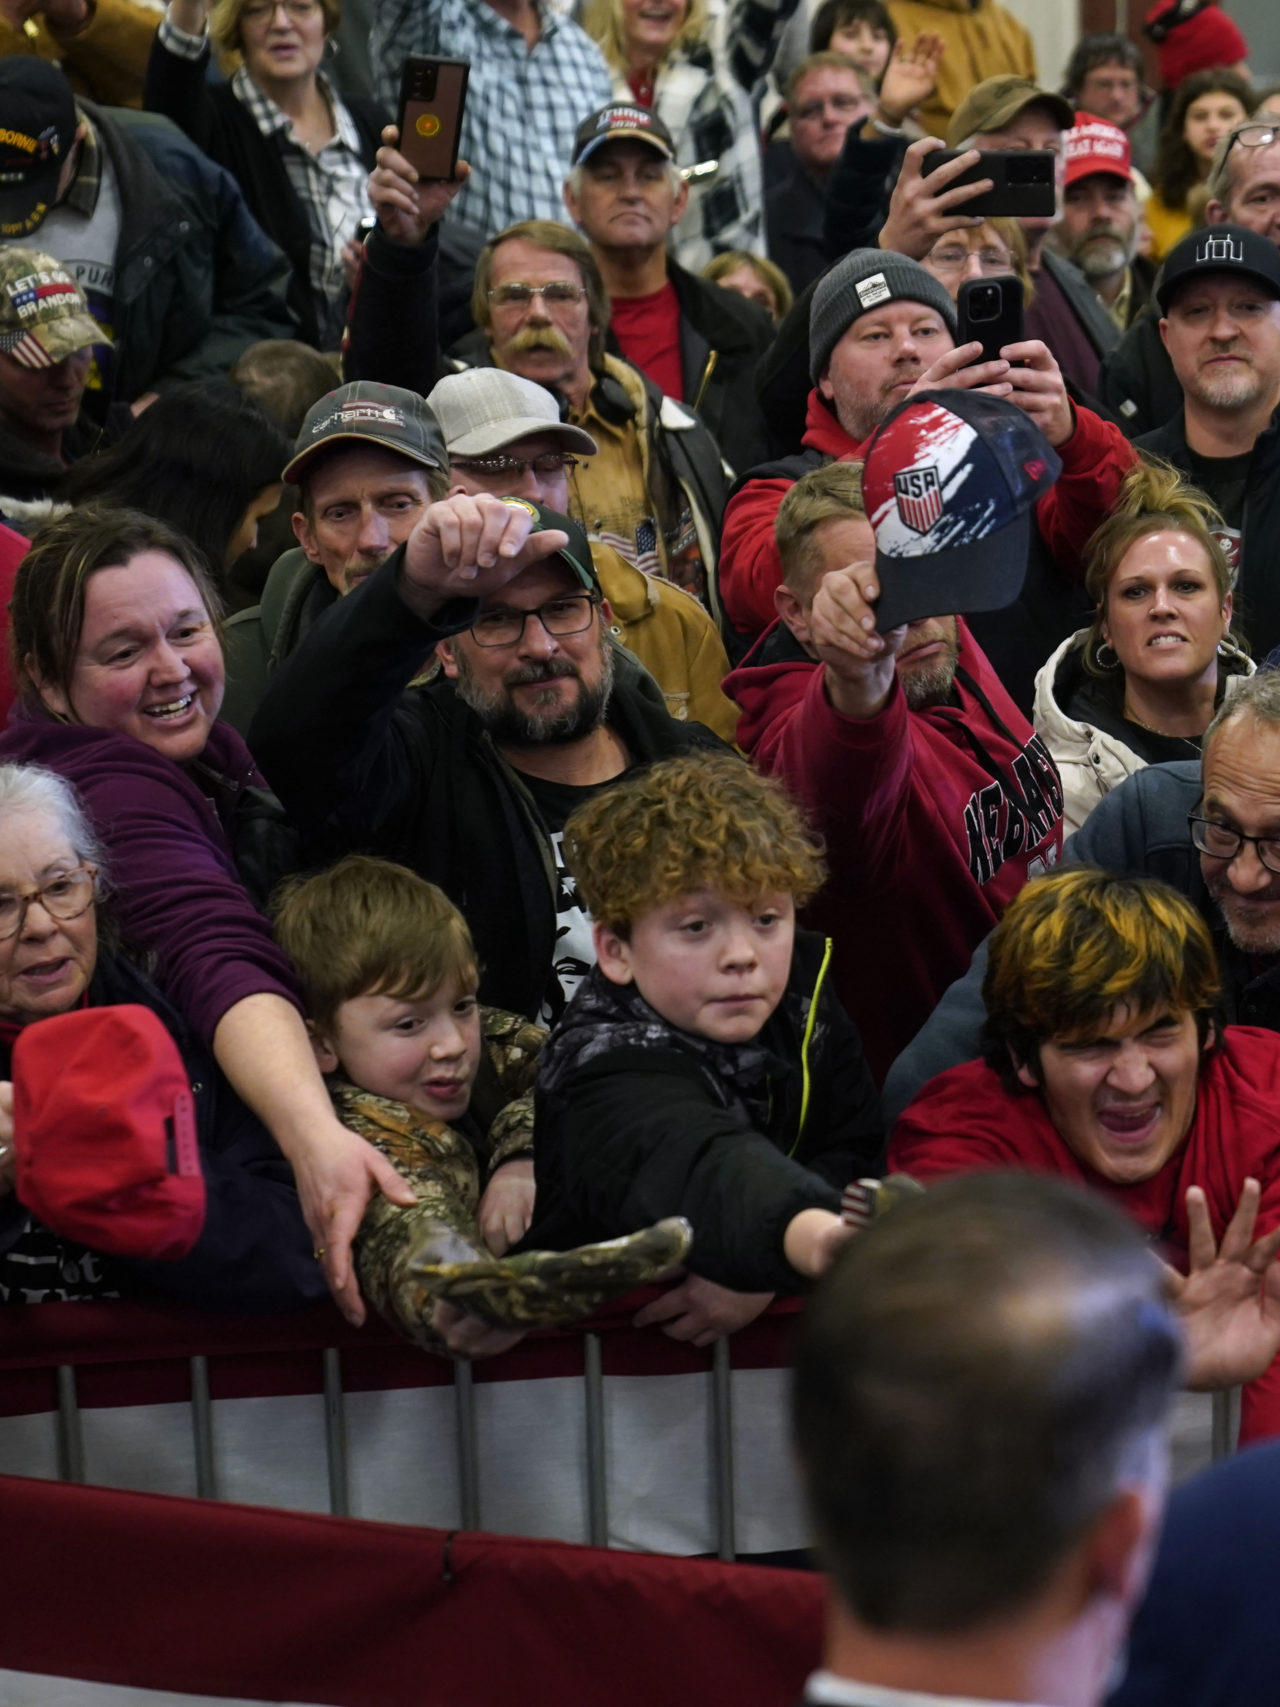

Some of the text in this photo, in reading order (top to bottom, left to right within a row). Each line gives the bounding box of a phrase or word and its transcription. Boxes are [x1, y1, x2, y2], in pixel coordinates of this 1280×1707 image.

[6, 270, 51, 297] LET'S
[17, 292, 82, 319] BRANDON
[897, 471, 936, 498] USA
